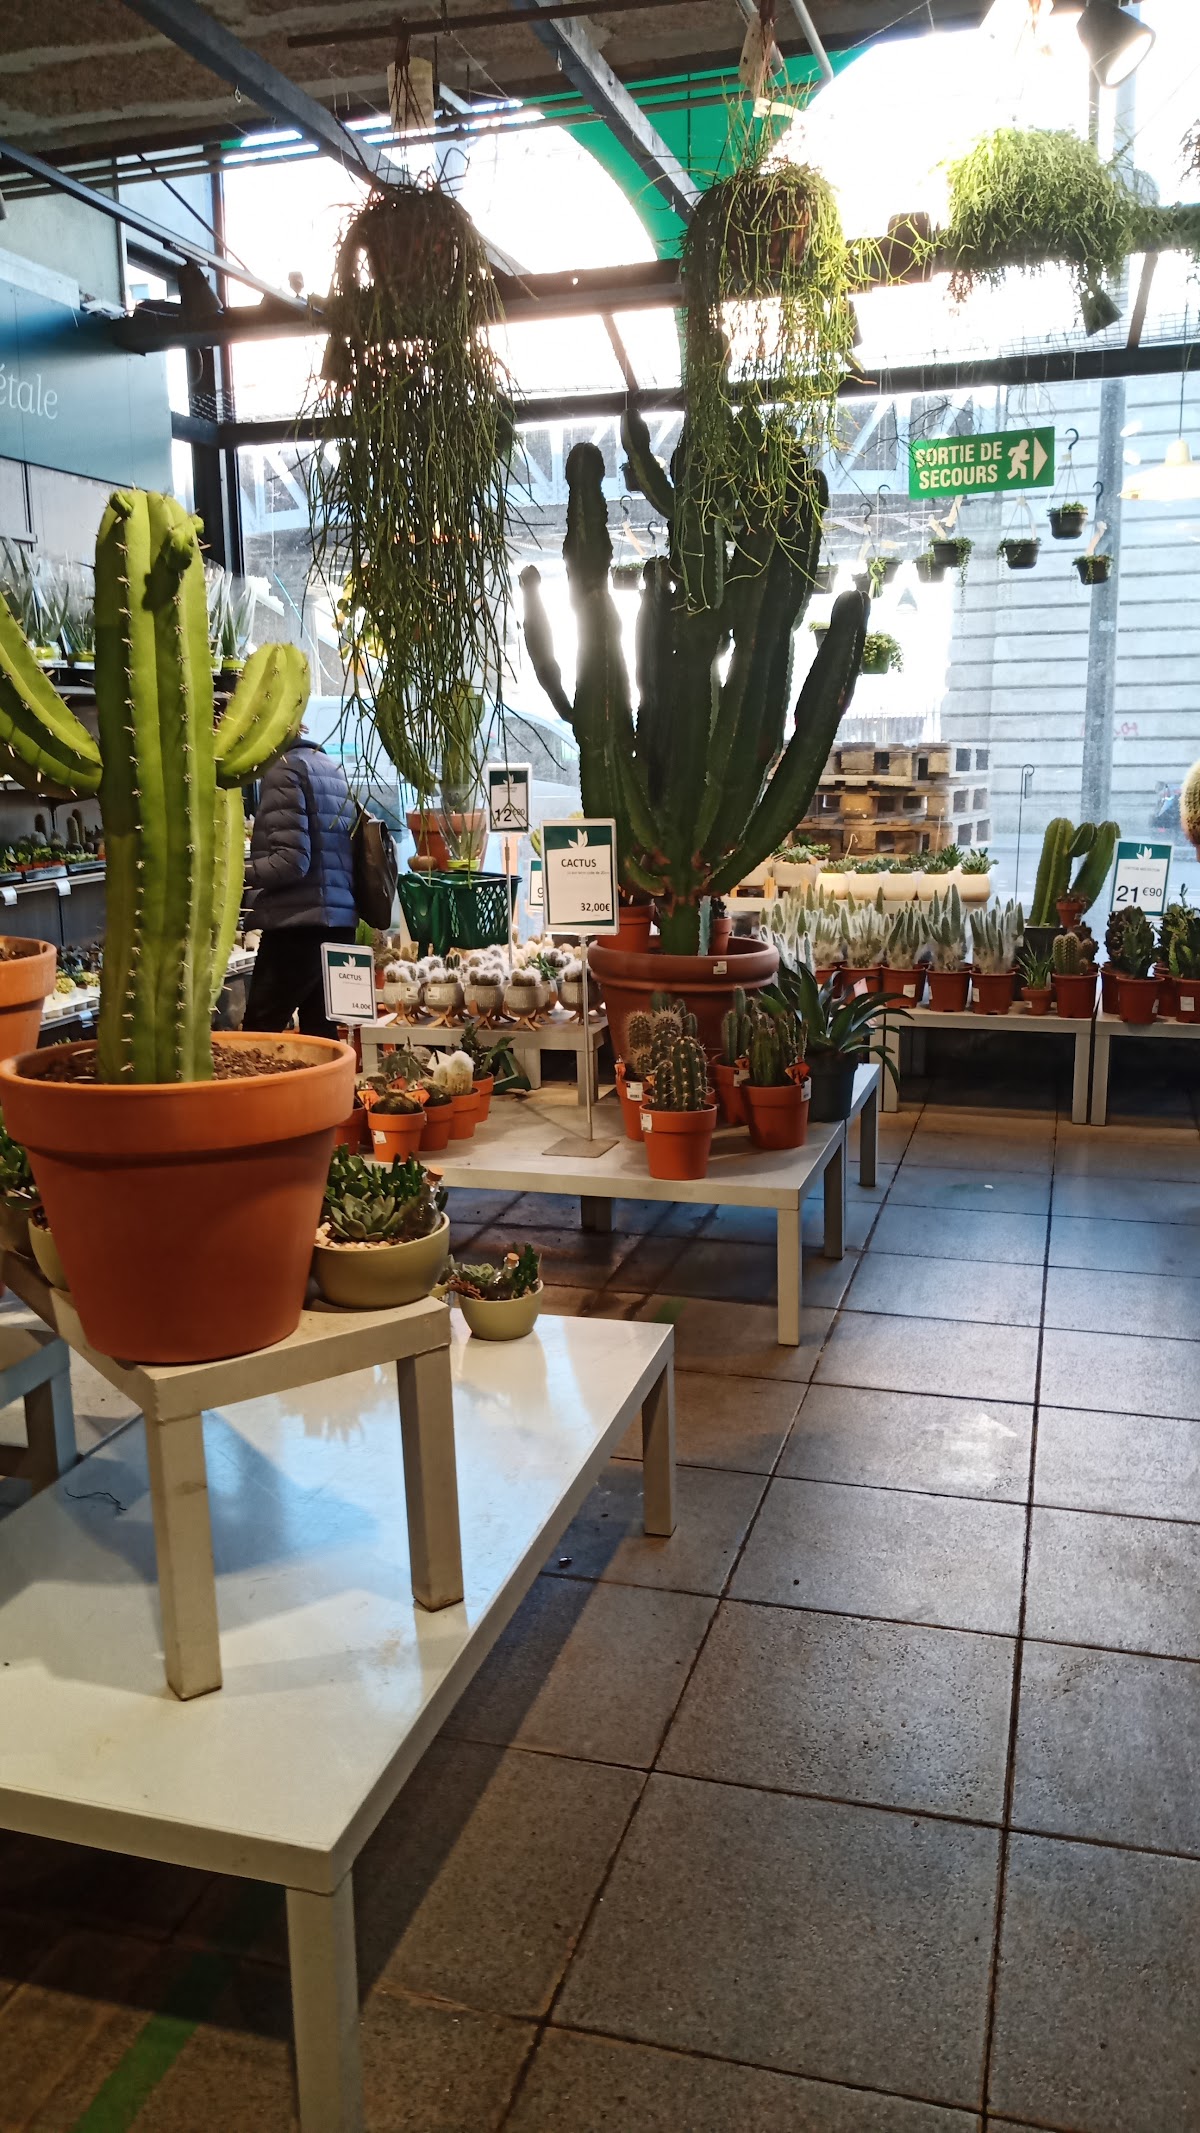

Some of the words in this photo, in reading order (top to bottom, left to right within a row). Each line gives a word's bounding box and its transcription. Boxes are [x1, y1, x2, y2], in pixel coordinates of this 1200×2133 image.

[915, 443, 975, 468] SORTIE
[980, 441, 1003, 461] DE
[919, 464, 998, 490] SECOURS
[495, 808, 512, 822] 12
[561, 858, 597, 868] CACTUS
[1116, 885, 1139, 903] 21
[1142, 887, 1163, 898] €90
[580, 902, 611, 913] 32,00€
[339, 972, 362, 981] CACTUS
